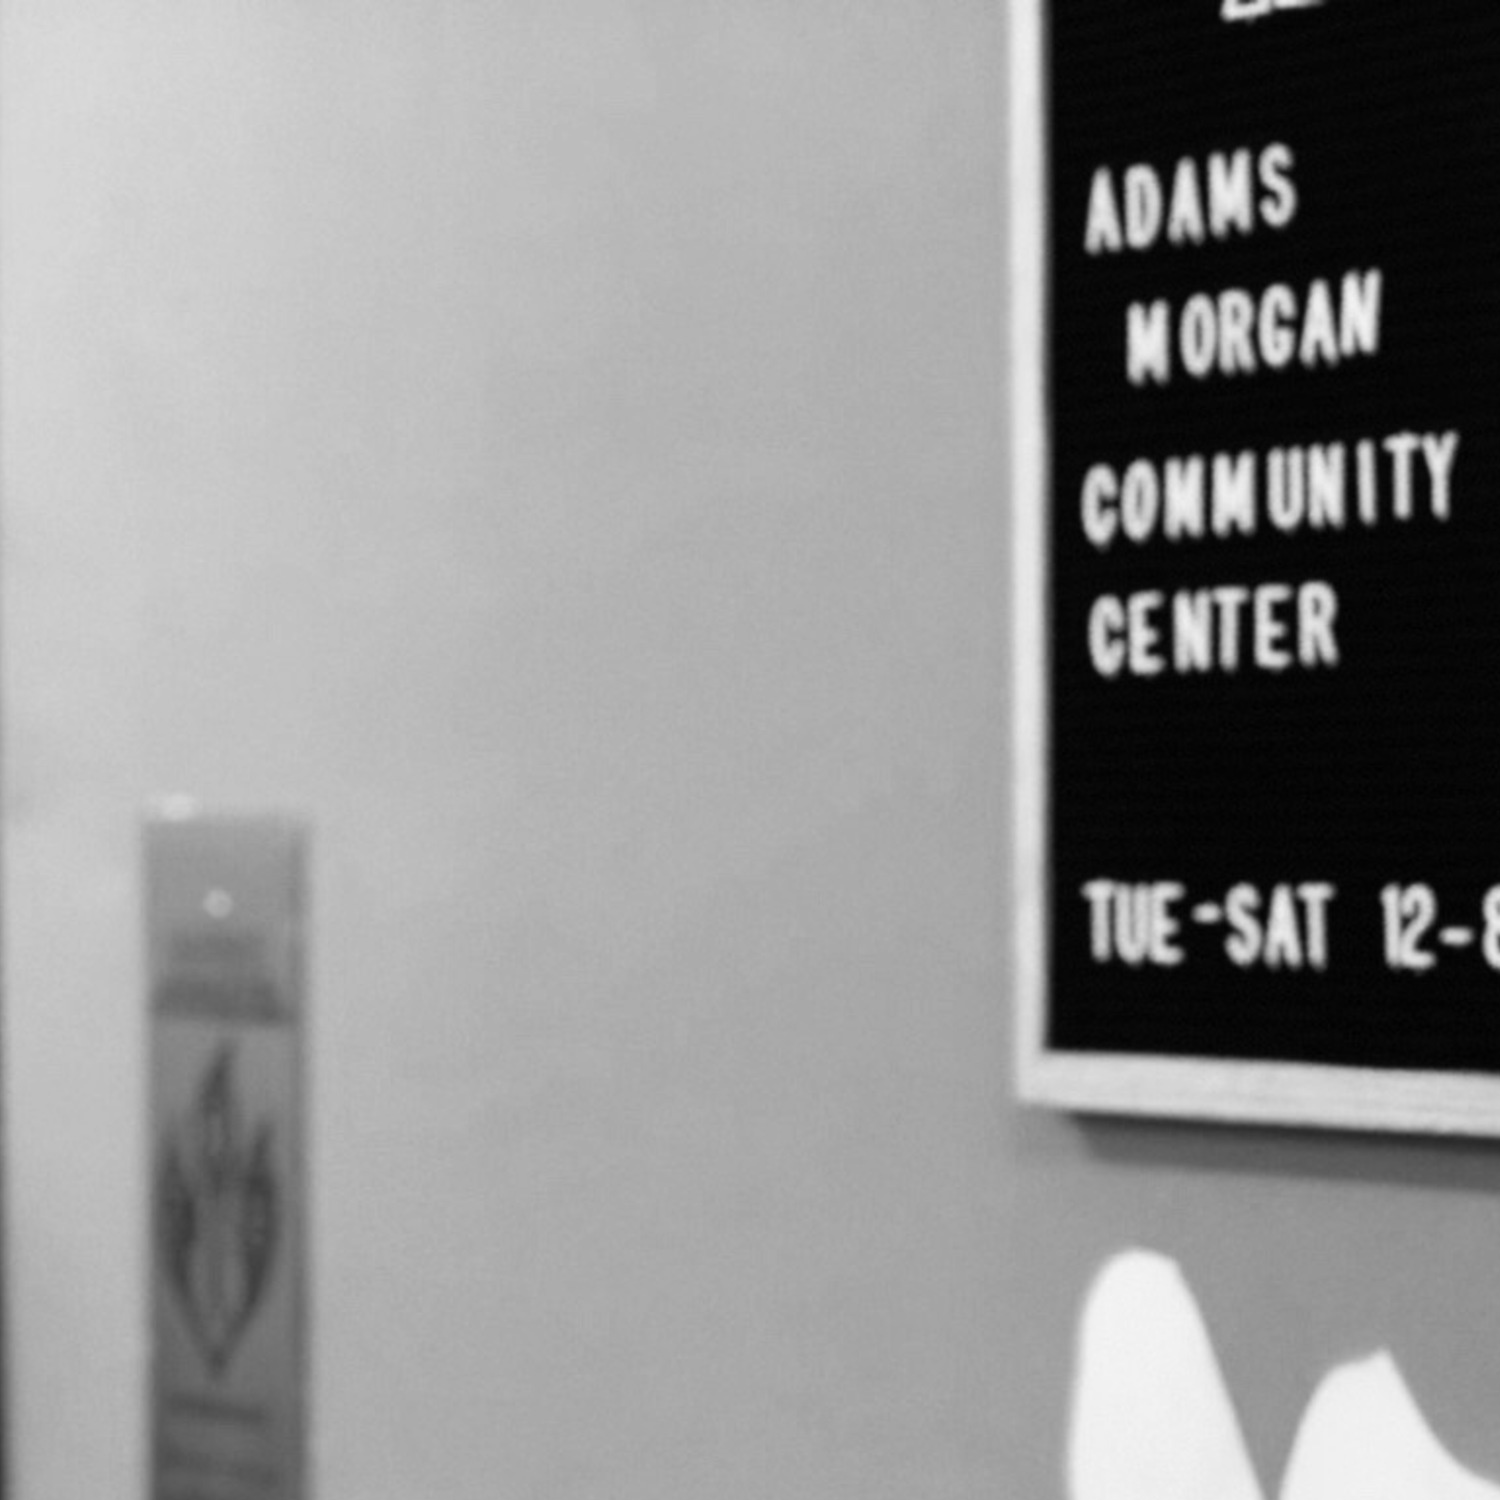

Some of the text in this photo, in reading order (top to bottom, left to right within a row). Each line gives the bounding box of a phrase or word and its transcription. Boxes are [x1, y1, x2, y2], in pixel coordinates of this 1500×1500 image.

[1084, 143, 1297, 254] ADAMS
[1126, 268, 1382, 385] MORGAN
[1080, 431, 1459, 546] COMMUNITY
[1088, 580, 1338, 676] CENTER
[1082, 879, 1335, 968] TUE-SAT
